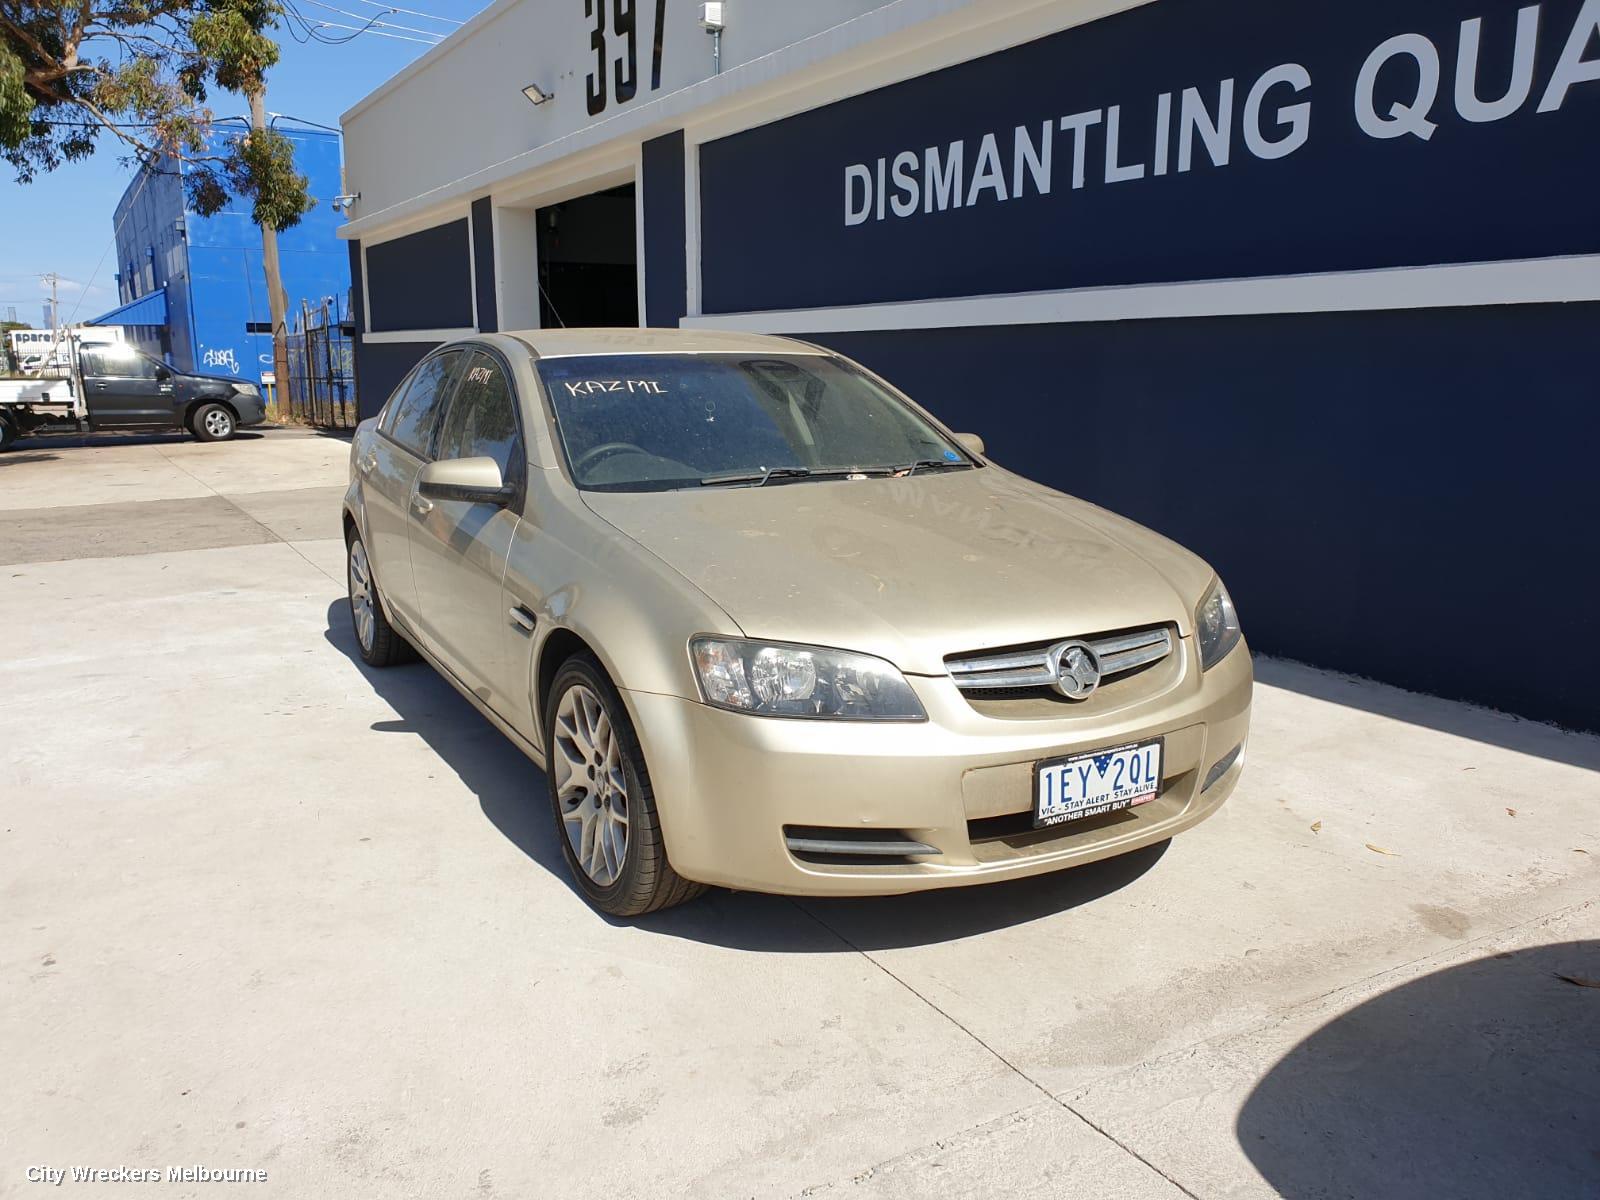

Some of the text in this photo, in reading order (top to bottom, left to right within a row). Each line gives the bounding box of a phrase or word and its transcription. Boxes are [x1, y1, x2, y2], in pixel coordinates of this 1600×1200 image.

[584, 0, 666, 116] 397
[843, 63, 1312, 227] DISMANTLING
[1041, 806, 1056, 816] VIC
[1064, 800, 1085, 811] STAY
[1086, 793, 1111, 806] ALERT
[1114, 788, 1132, 799] STAY
[1084, 804, 1111, 818] SMART
